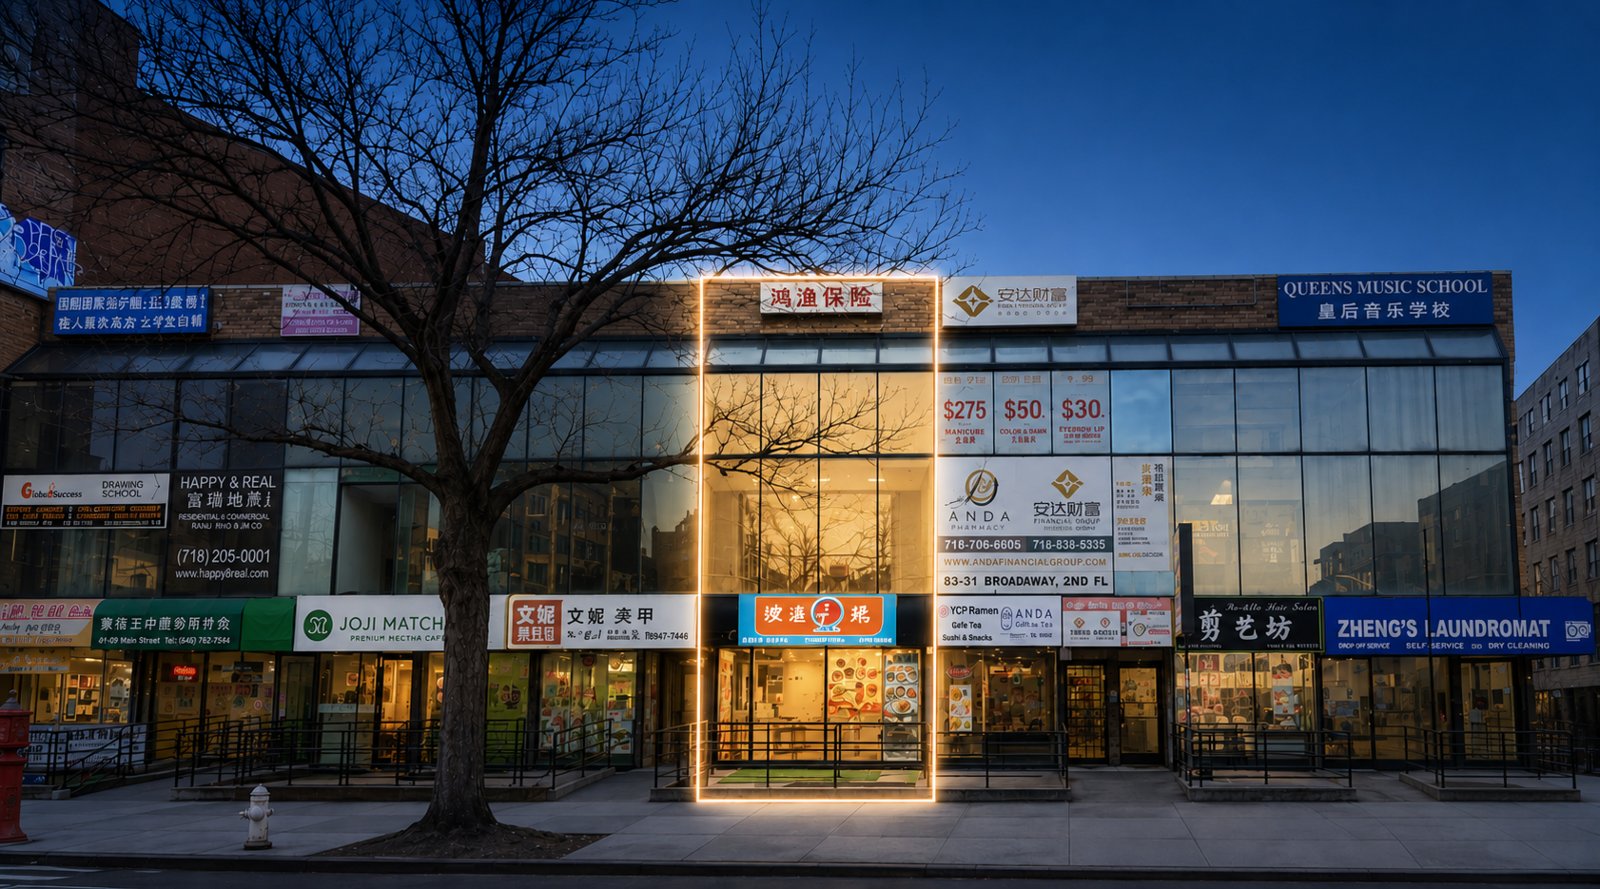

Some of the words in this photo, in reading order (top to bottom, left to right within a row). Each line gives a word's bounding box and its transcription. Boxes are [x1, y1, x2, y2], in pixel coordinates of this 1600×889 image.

[1284, 281, 1352, 298] QUEENS
[1357, 280, 1412, 294] MUSIC
[1416, 279, 1488, 294] SCHOOL
[771, 287, 873, 308] 鸿渔保险
[1318, 301, 1450, 319] 皇后音乐学校
[944, 399, 986, 421] $275
[102, 481, 144, 489] DRAWING
[180, 476, 226, 489] HAPPY
[229, 476, 239, 489] &
[242, 475, 276, 489] REAL
[102, 489, 142, 498] SCHOOL
[949, 511, 1010, 522] ANDA
[1034, 502, 1100, 517] 安达财富
[177, 549, 209, 566] (718)
[211, 549, 270, 563] 205-0001
[944, 558, 1107, 567] WWW.ANDAFINANCIALGROUP.COM
[944, 576, 977, 586] 83-31
[984, 576, 1059, 588] BROADAWAY,
[1063, 576, 1089, 587] 2ND
[1094, 576, 1109, 587] FL
[950, 606, 967, 615] YCP
[969, 606, 999, 615] Ramen
[1015, 609, 1053, 618] ANDA
[340, 617, 376, 630] JOJI
[1199, 608, 1292, 642] 剪艺坊
[1338, 620, 1418, 637] ZHENG'S
[1425, 619, 1551, 637] LAUNDROMAT
